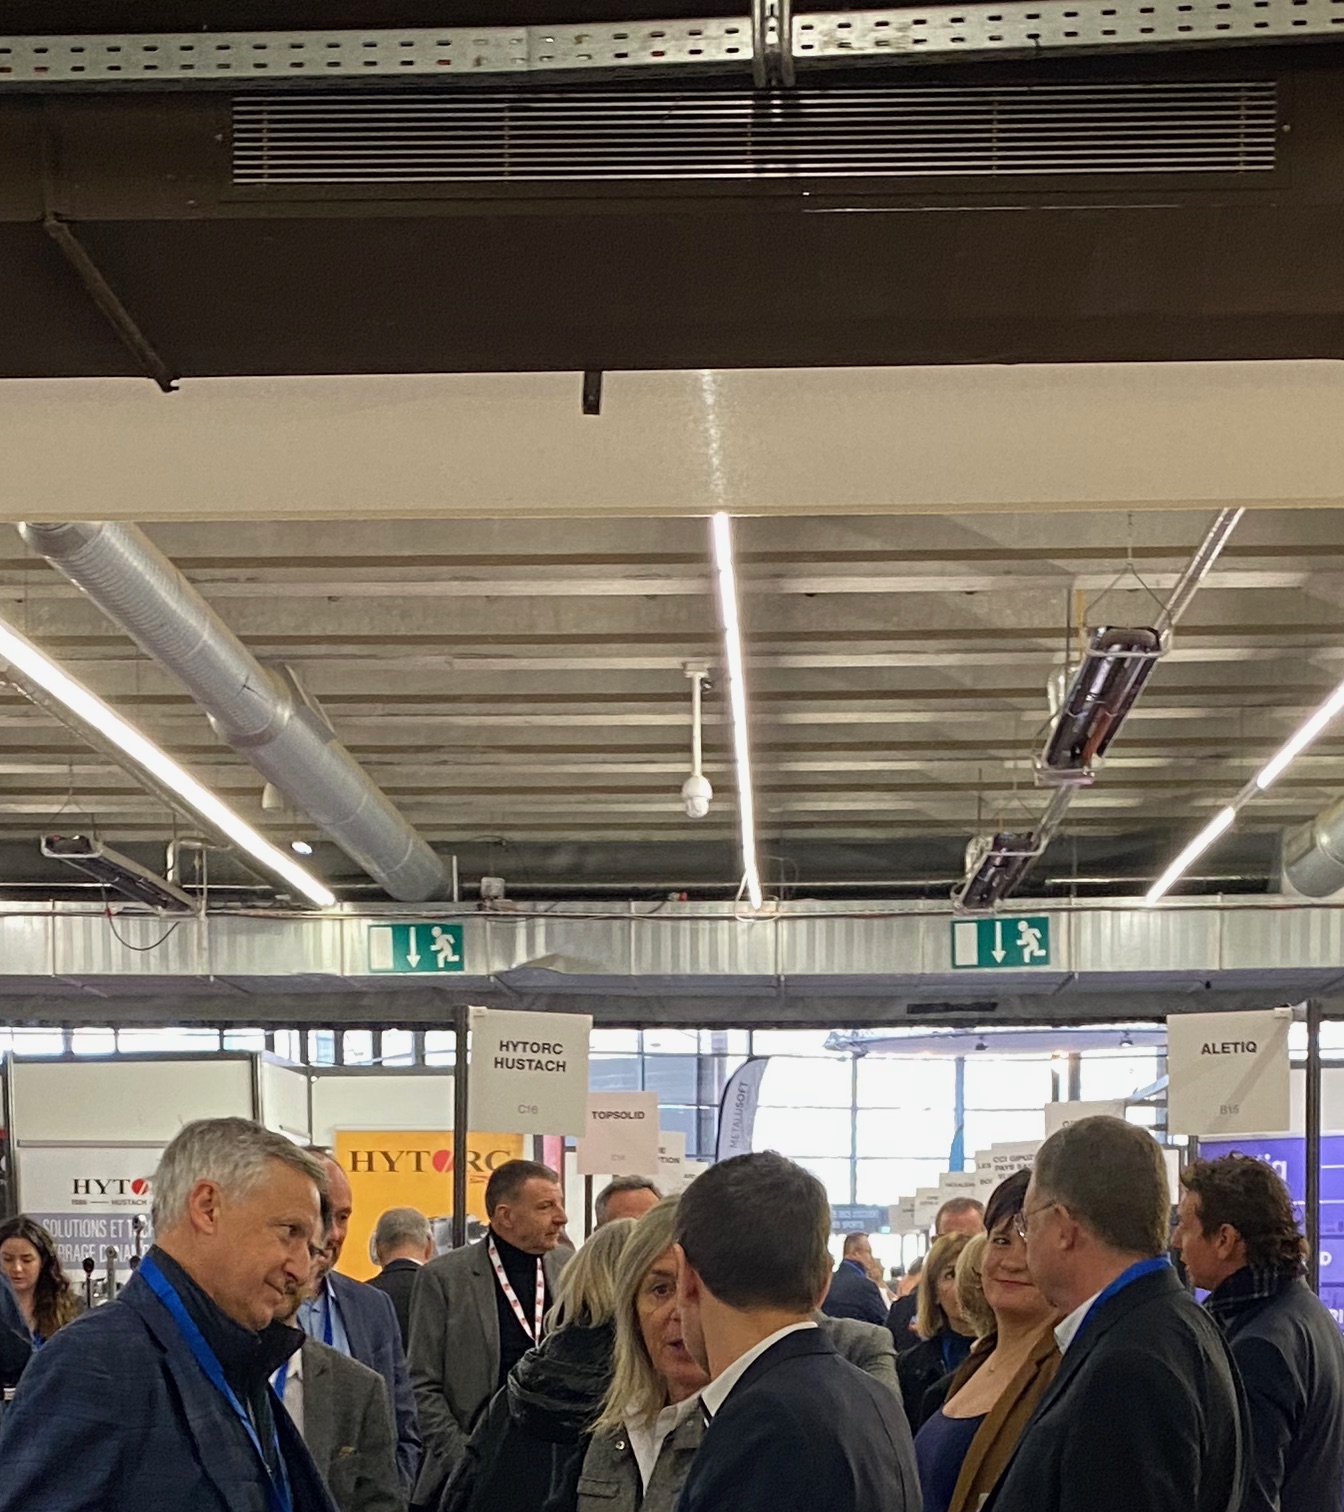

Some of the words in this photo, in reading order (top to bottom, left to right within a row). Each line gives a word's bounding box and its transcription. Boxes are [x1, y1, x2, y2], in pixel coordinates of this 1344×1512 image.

[500, 1040, 564, 1055] HYTORC
[1201, 1042, 1257, 1055] ALETIQ
[494, 1057, 567, 1072] HUSTACH
[592, 1111, 645, 1120] TOPSOLID
